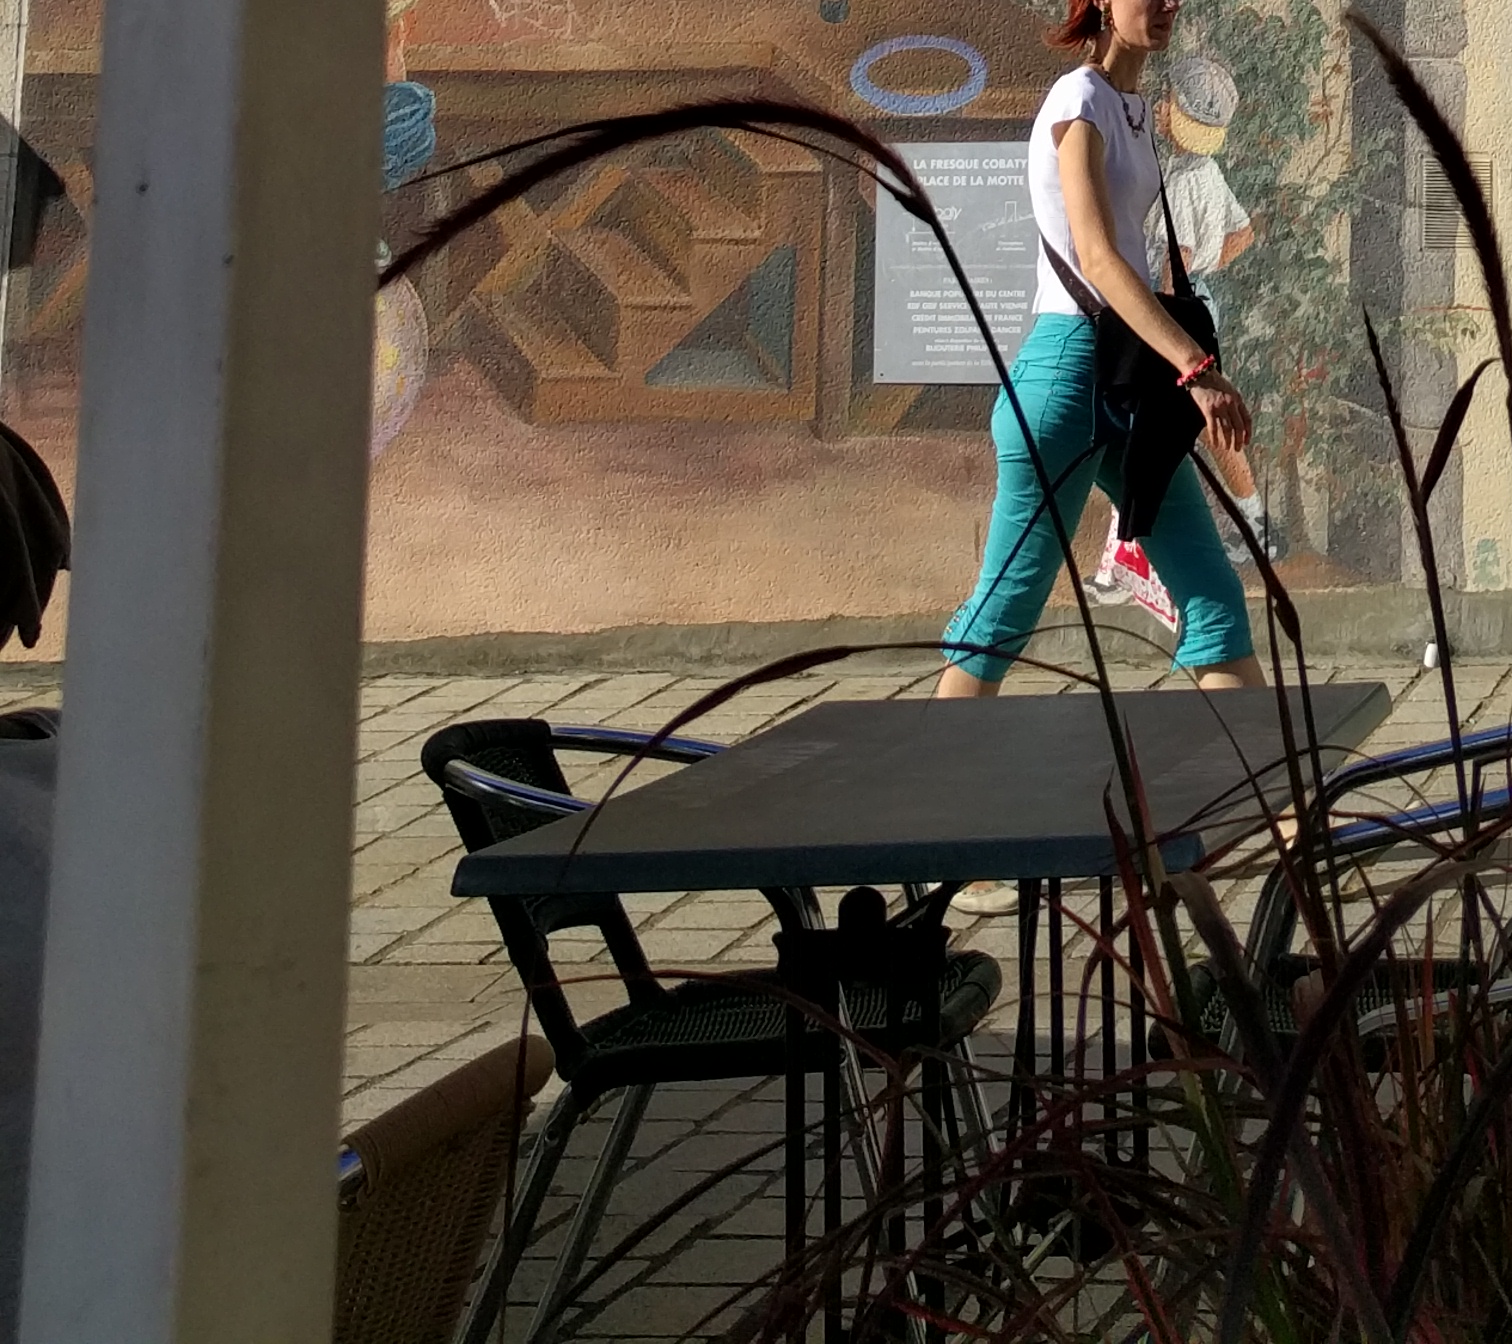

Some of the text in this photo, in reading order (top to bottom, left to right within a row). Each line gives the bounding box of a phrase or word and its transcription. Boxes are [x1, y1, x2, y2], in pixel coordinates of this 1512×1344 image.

[913, 158, 1028, 170] LA FRESQUE COBATY
[917, 175, 1025, 186] PLACE DE LA MOTTE
